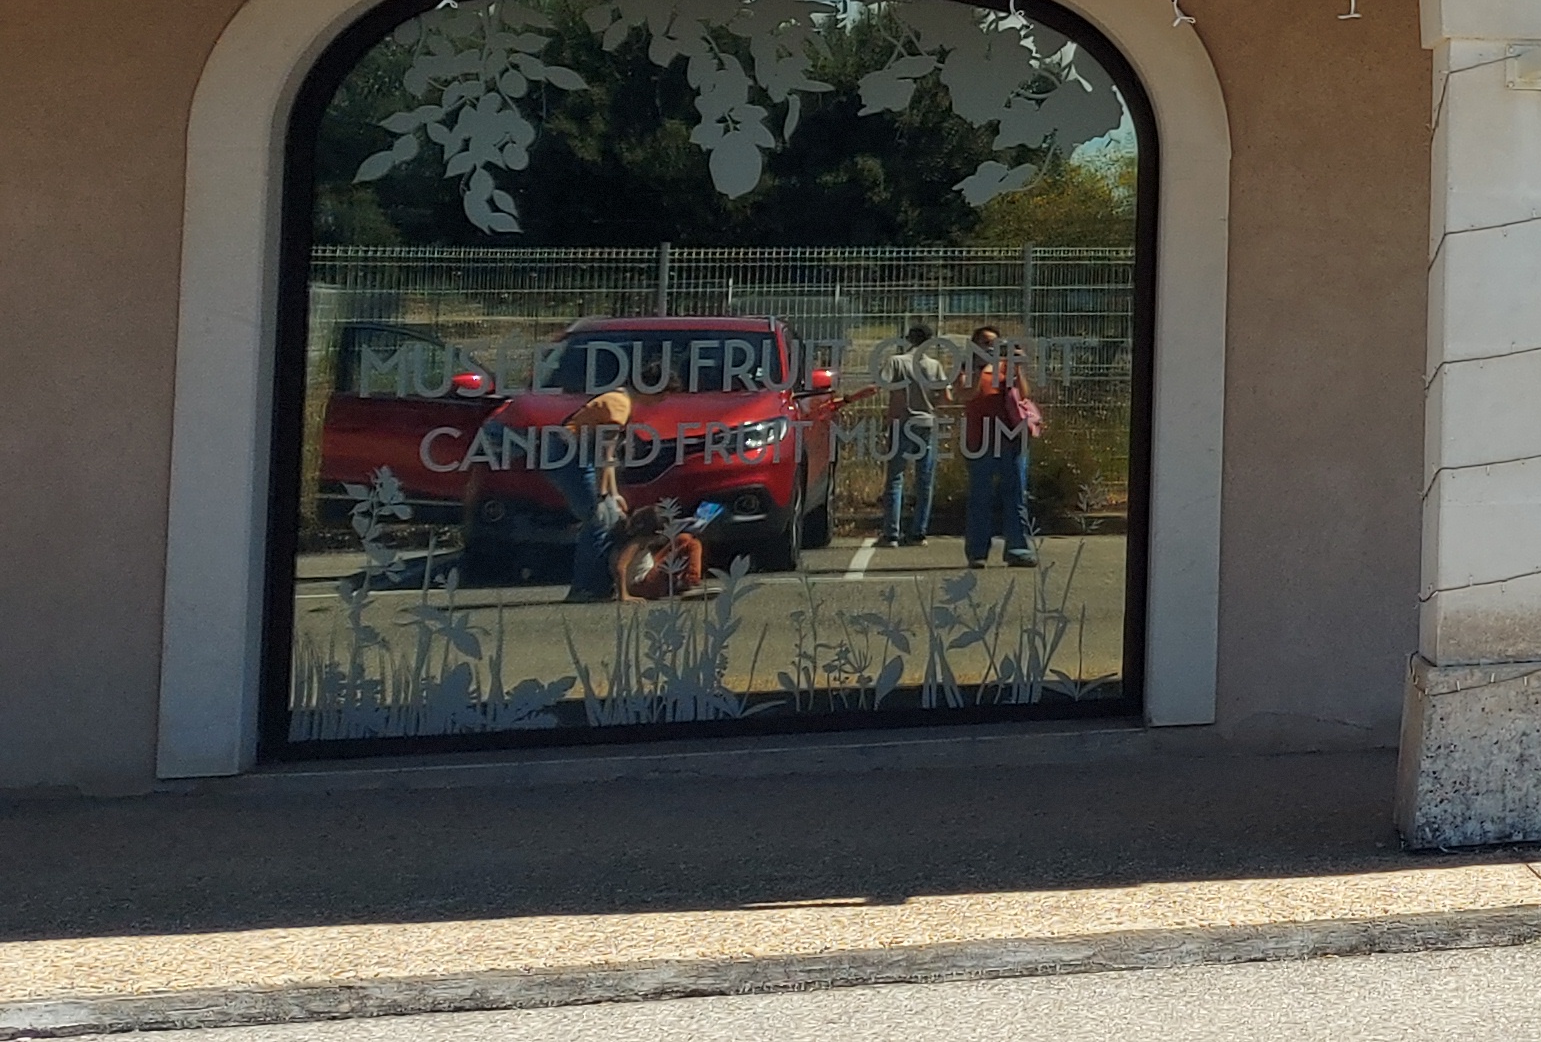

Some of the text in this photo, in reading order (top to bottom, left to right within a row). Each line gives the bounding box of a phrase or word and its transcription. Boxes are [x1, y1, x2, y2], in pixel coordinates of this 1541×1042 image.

[586, 340, 672, 396] DU
[688, 338, 849, 394] FRUIT
[869, 336, 1086, 391] CONFIT
[419, 415, 1030, 473] CANDIED FRUIT MUSEUM
